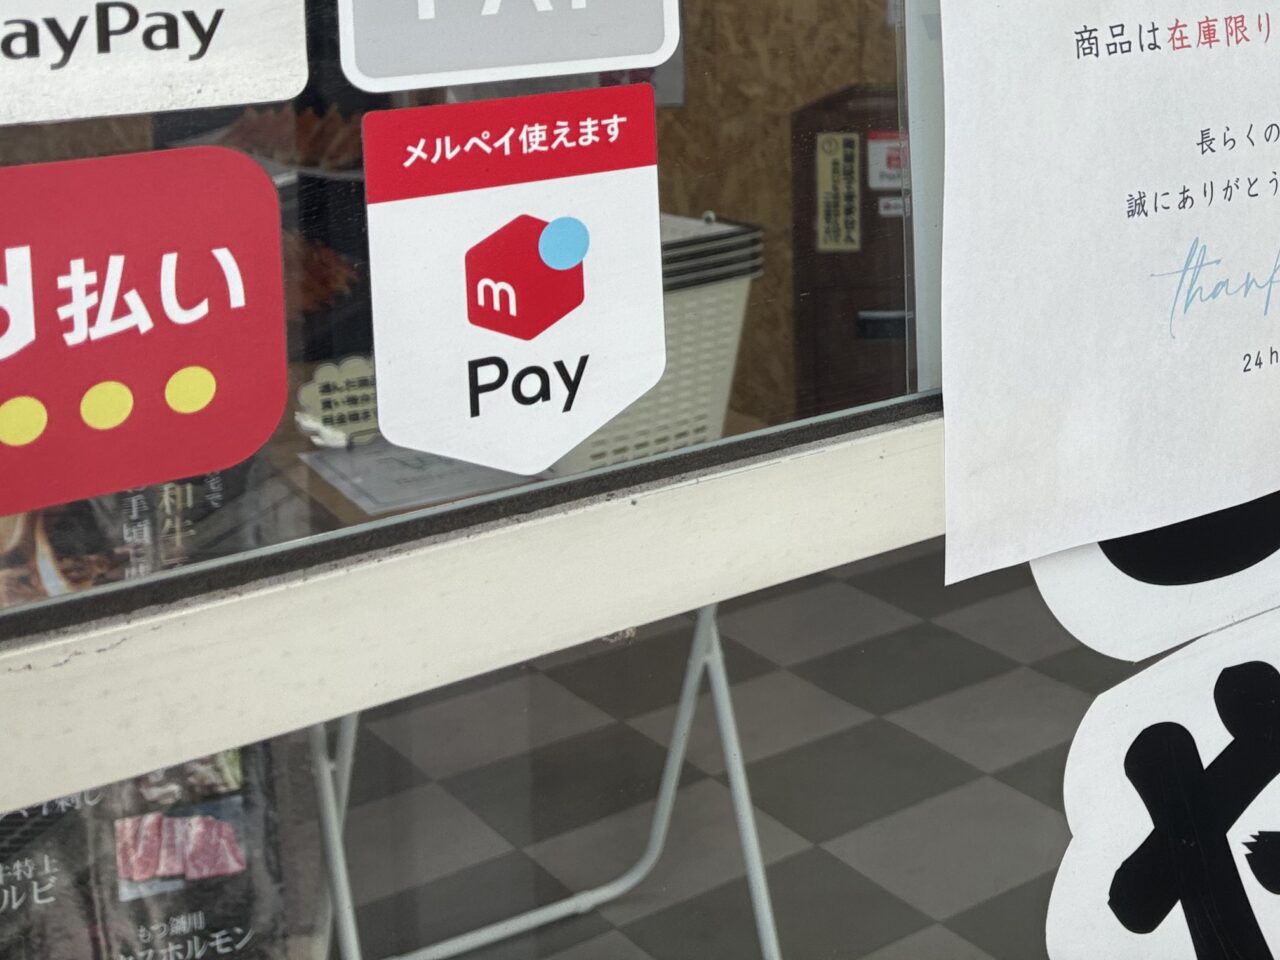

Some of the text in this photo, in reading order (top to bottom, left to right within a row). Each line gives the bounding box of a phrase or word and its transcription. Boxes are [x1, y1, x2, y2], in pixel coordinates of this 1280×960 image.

[402, 114, 628, 168] メルペイ使えます
[467, 353, 590, 418] Pay
